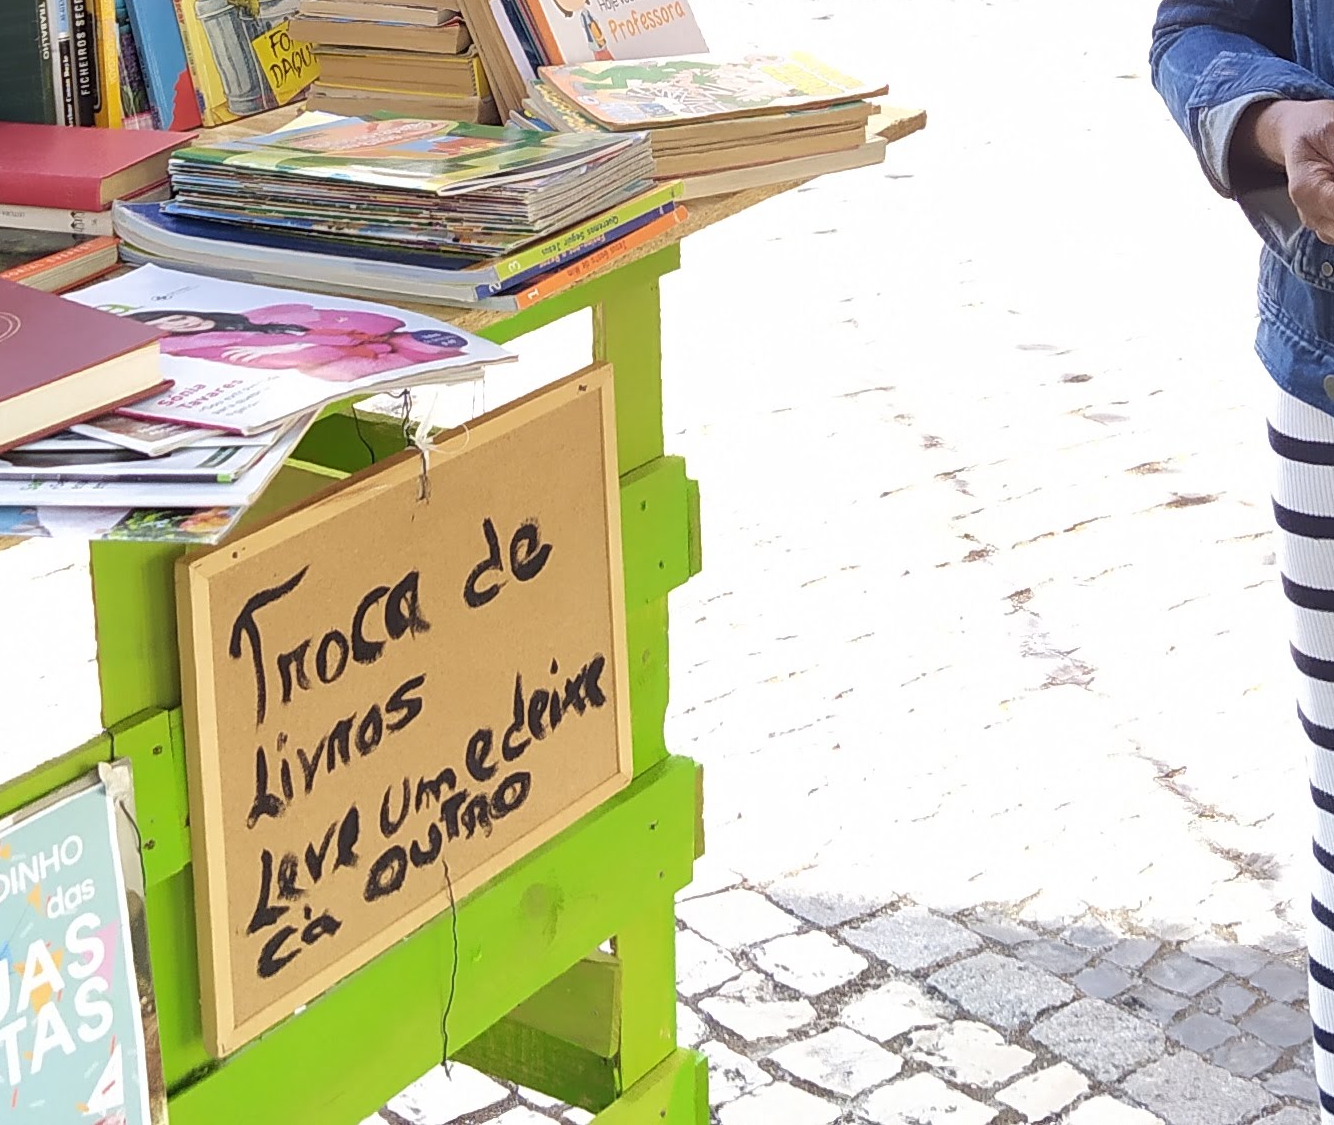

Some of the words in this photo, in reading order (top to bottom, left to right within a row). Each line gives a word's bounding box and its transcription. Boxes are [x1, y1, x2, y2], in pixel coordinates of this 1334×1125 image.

[38, 1, 51, 61] TRABALHO
[608, 0, 685, 43] Professora
[80, 31, 91, 96] FICHEIROS
[564, 231, 586, 248] Seguir
[587, 216, 619, 238] Queremos
[508, 260, 521, 273] 3
[541, 242, 561, 256] Jesus
[527, 287, 540, 300] 1
[157, 382, 208, 408] Sónia
[178, 378, 244, 412] Tavares
[229, 565, 431, 725] Troca
[464, 517, 554, 610] de
[247, 673, 427, 830] Livros
[247, 802, 361, 938] Leve
[45, 877, 97, 922] das
